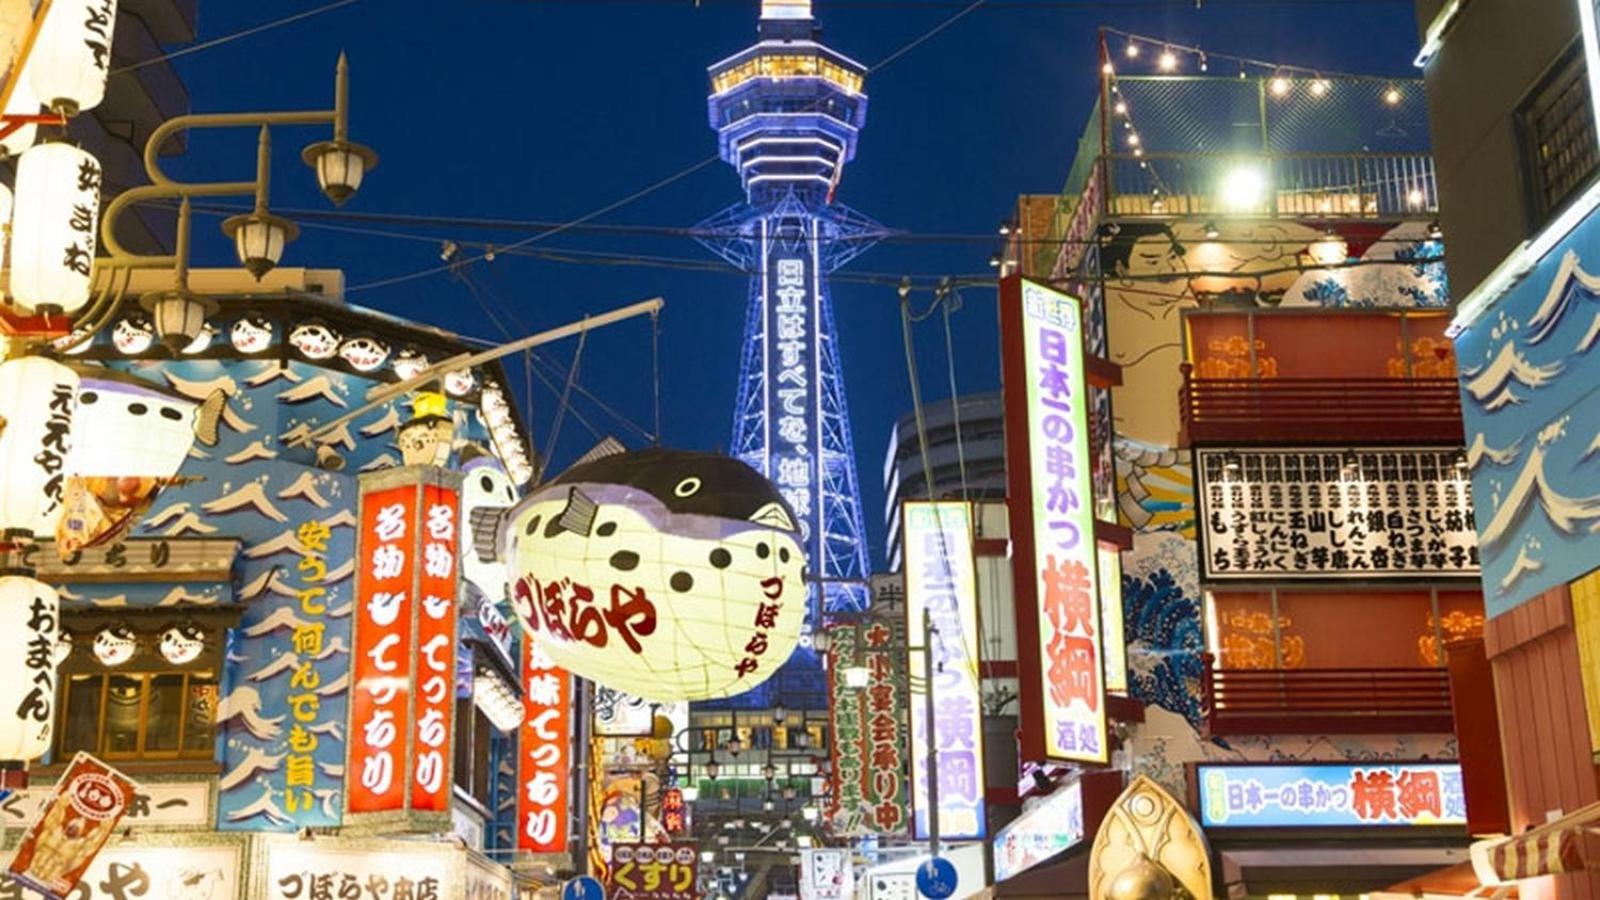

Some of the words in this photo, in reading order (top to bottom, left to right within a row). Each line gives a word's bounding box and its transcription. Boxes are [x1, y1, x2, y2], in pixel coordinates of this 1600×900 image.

[1039, 326, 1081, 550] 日本一の串かつ
[1210, 511, 1230, 570] もち
[1269, 511, 1289, 570] にんにく
[1288, 511, 1310, 569] 玉ねぎ
[1307, 510, 1329, 568] 山芋
[1347, 510, 1370, 569] れんこん
[1387, 510, 1409, 568] 白ねぎ
[1407, 510, 1427, 568] さつま芋
[1426, 509, 1447, 568] じゃが芋
[1445, 509, 1468, 568] 茄子
[512, 571, 658, 656] づぼらや
[735, 575, 786, 680] づぼらや
[1042, 554, 1098, 713] 横綱
[362, 634, 401, 796] てっちり
[416, 634, 450, 795] てっちり
[864, 623, 901, 831] 大小宴会承り中
[1057, 719, 1099, 754] 酒処
[1227, 781, 1348, 811] 日本一の串かつ
[1350, 770, 1442, 820] 横綱
[613, 862, 693, 893] くすり
